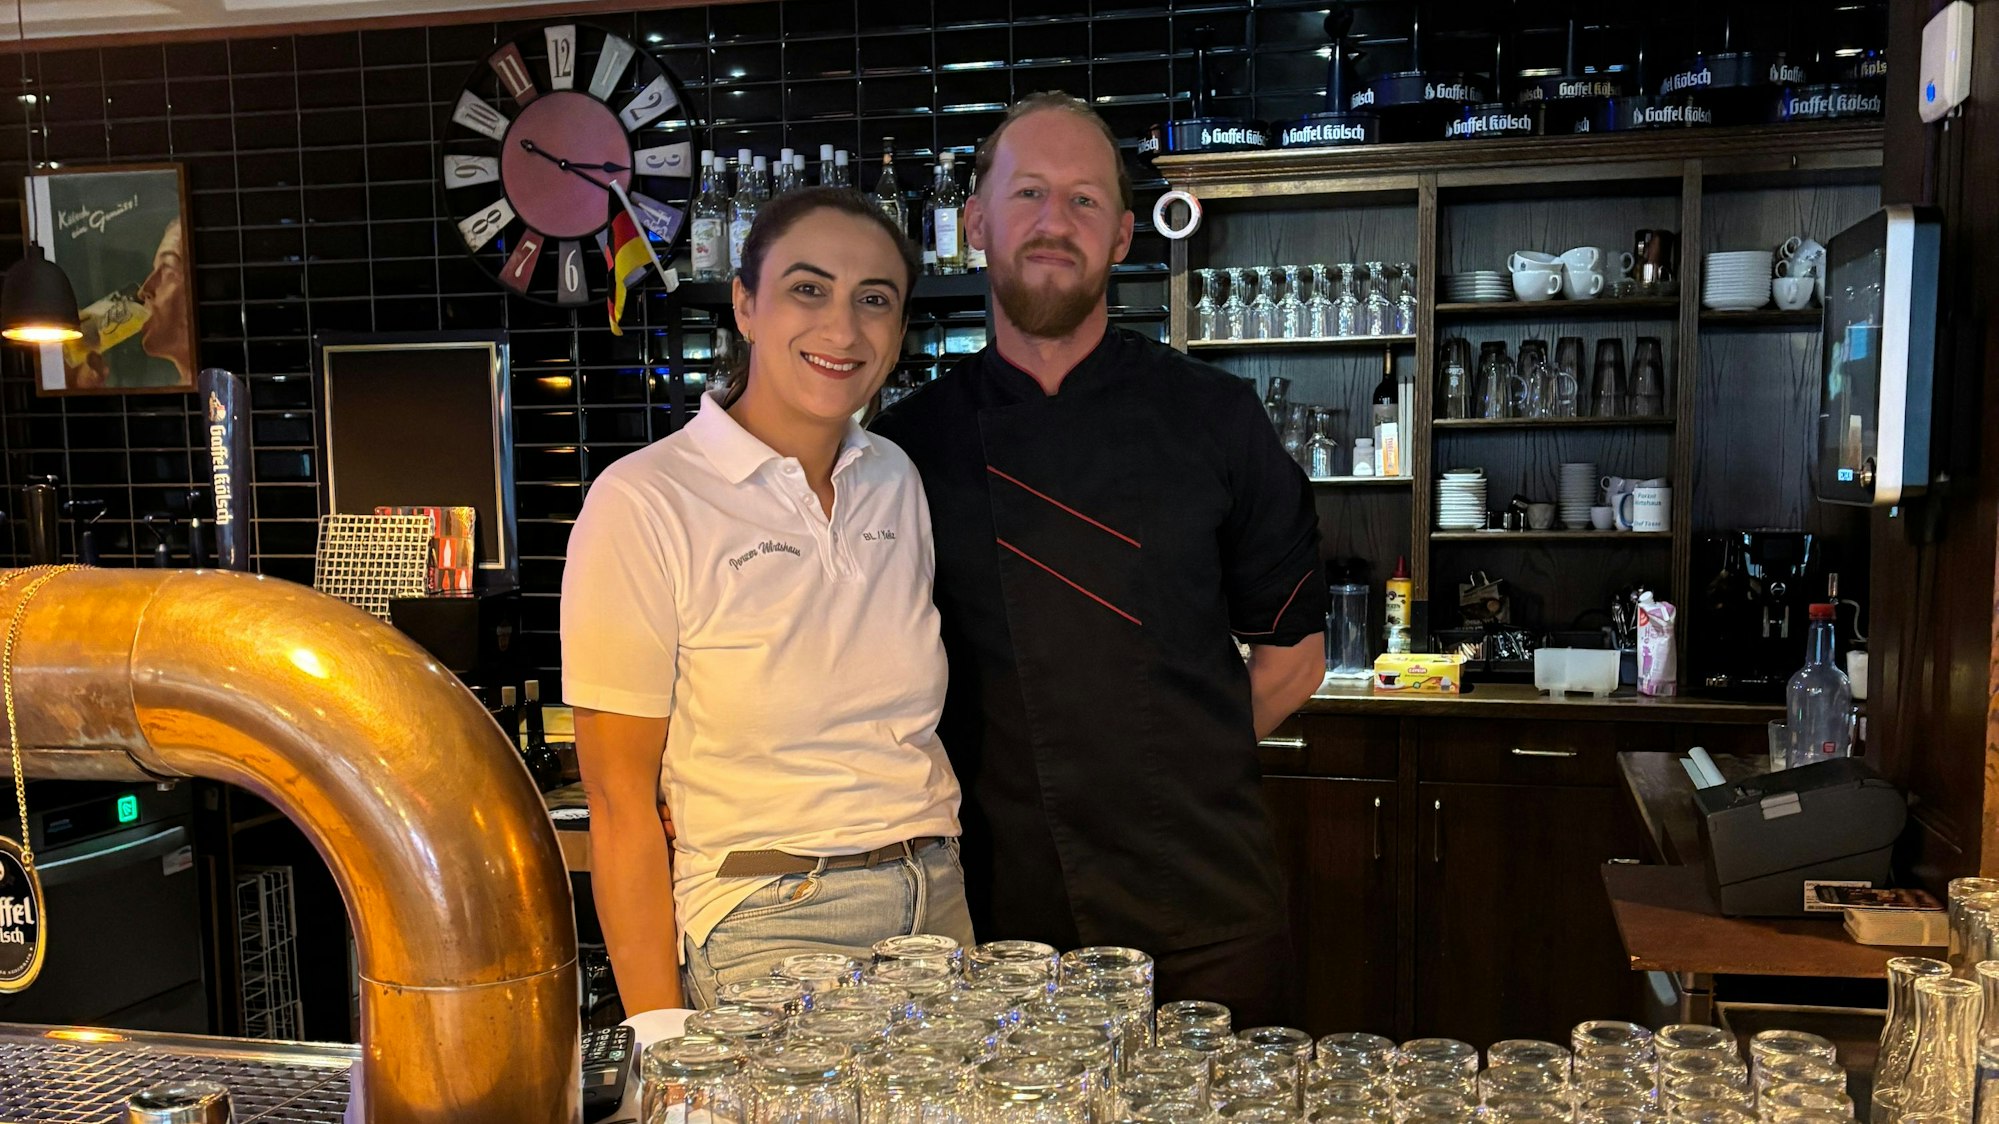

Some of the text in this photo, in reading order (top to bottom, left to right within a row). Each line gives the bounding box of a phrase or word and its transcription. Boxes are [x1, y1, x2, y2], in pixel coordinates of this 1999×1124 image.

[551, 37, 572, 79] 12
[601, 50, 620, 88] 1
[497, 54, 534, 98] 11
[1436, 83, 1469, 101] Gaffel
[1559, 82, 1592, 97] Gaffel
[629, 91, 664, 122] 2
[1645, 105, 1684, 123] Gaffel
[1789, 94, 1881, 115] Gaffel Kölsch
[464, 102, 500, 135] 10
[1453, 113, 1532, 135] Gaffel Kölsch
[1212, 128, 1246, 145] Gaffel
[1290, 123, 1365, 144] Gaffel Kölsch
[453, 163, 489, 180] 9
[645, 153, 681, 169] 3
[470, 208, 503, 235] 8
[514, 240, 538, 278] 7
[564, 249, 579, 293] 6
[209, 425, 234, 526] Gaffel Kölsch
